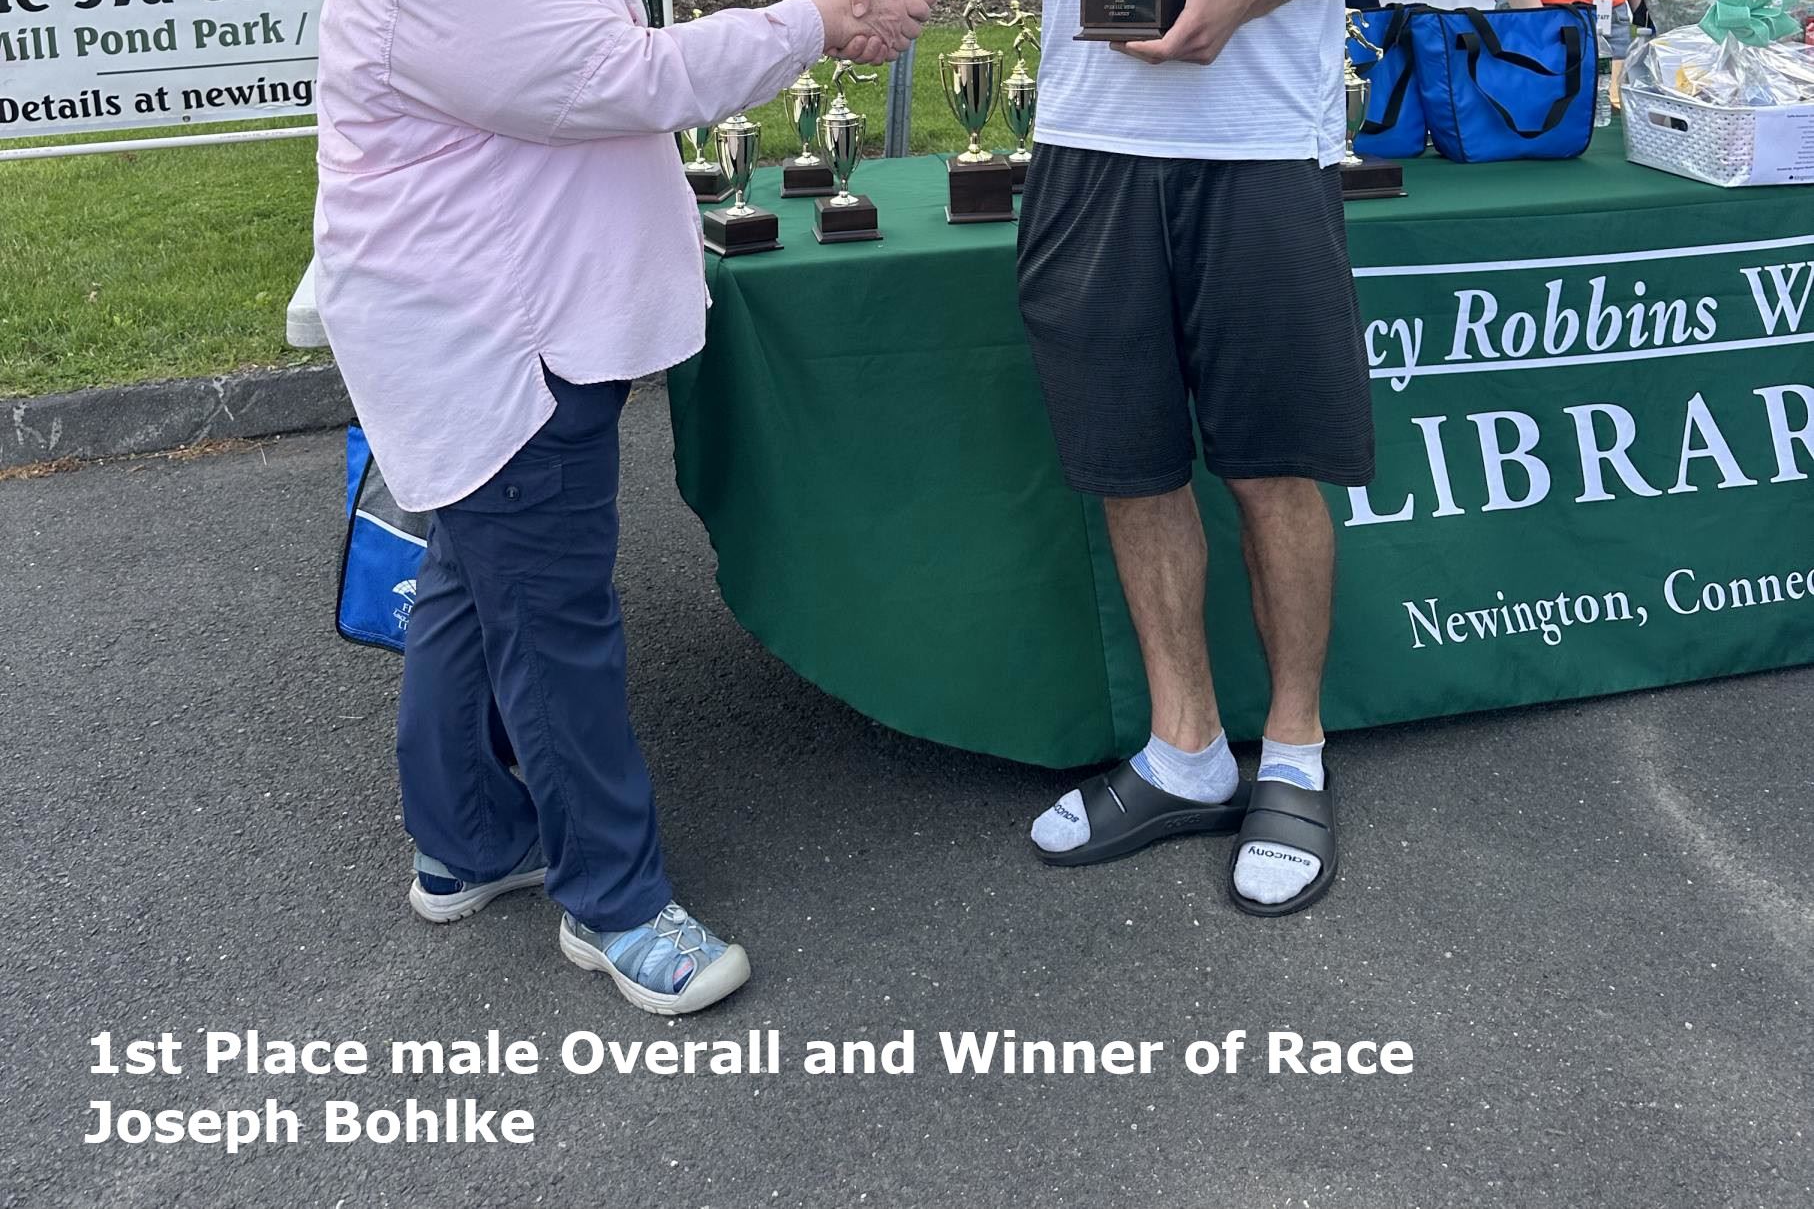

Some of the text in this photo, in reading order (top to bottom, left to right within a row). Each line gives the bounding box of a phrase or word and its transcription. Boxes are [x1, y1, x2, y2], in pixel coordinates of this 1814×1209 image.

[73, 18, 178, 57] Pond
[192, 12, 286, 49] Park
[0, 76, 317, 124] Details at newing
[1443, 275, 1719, 362] Robbins
[1738, 260, 1814, 336] W
[1402, 590, 1649, 650] Newington,
[1247, 845, 1312, 866] saucony
